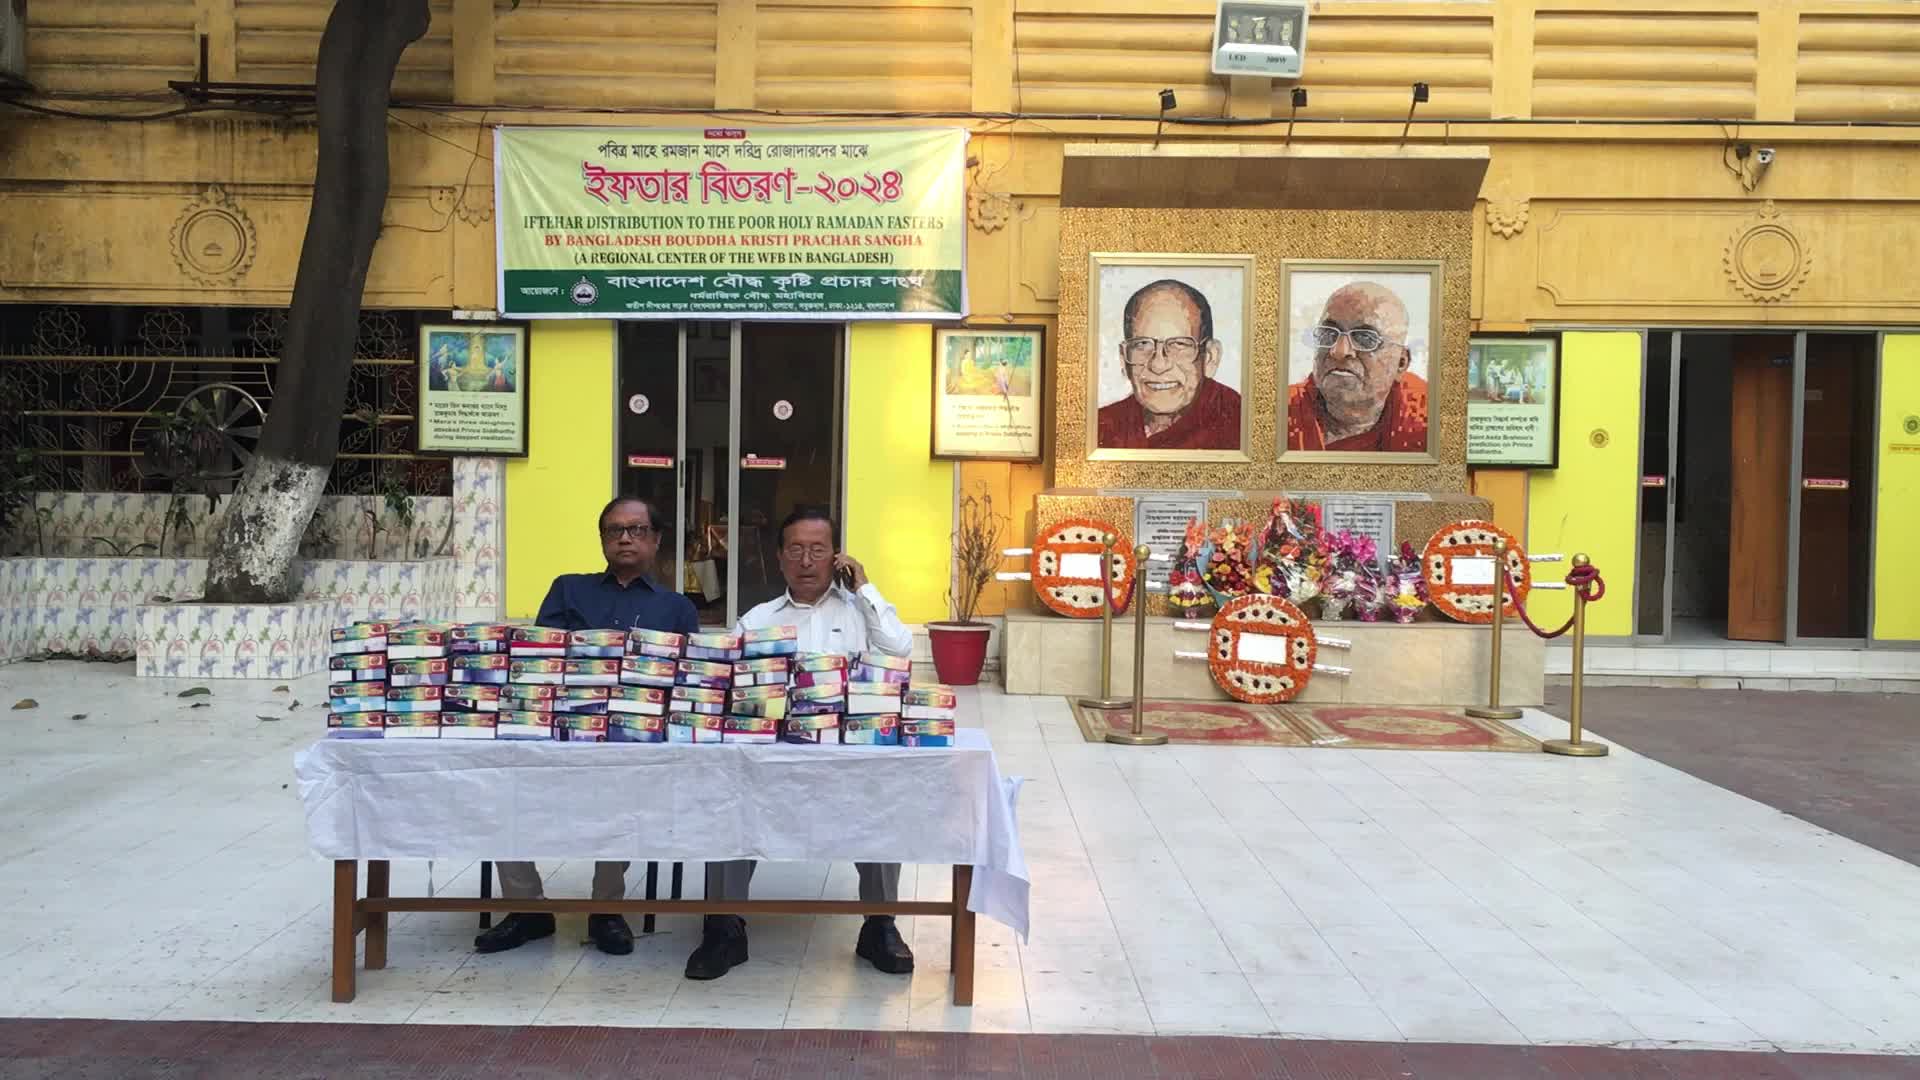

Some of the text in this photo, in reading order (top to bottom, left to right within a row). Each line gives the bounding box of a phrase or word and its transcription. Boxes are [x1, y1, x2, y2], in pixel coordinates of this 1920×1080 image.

[598, 140, 869, 160] পবিত্র মাহে রমজান মাসে দরিদ্র রোজাদারদের মাঝে
[583, 160, 691, 205] ইফতার
[524, 215, 944, 230] IFTEHAR DISTRIBUTION TO THE POOR HOLY RAMADAN FASTERS
[544, 234, 923, 246] BY BANGLADESH BOUDDHA KRISTI PRACHAR SANGHA
[574, 252, 894, 265] (A REGIONAL CENTER OF THE WFB IN BANGLADESH)
[606, 272, 926, 292] বাংলাদেশ বৌদ্ধ কৃষ্টি প্রচার সংঘ
[744, 290, 770, 300] বৌদ্ধ
